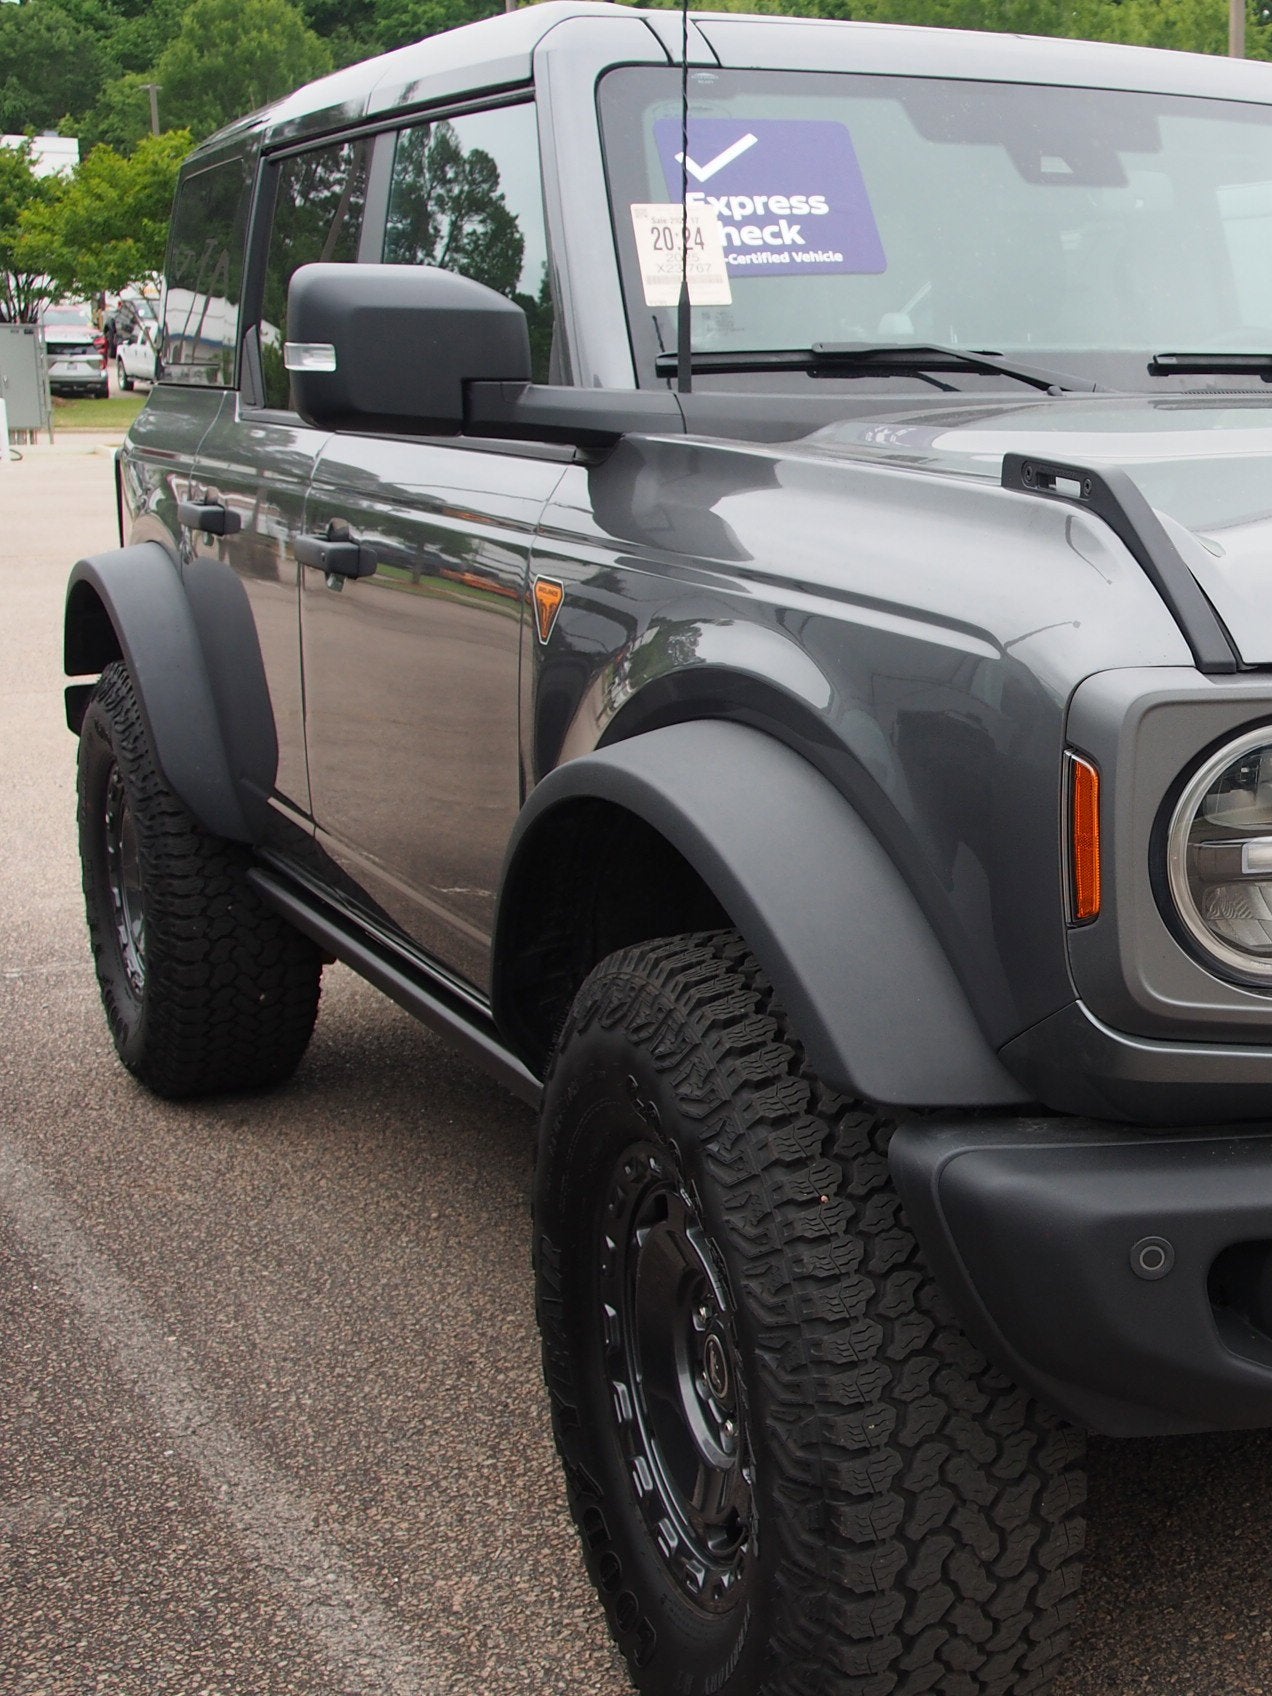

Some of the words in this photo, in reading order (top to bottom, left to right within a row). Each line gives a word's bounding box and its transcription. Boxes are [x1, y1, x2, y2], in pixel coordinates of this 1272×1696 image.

[651, 226, 705, 251] 20:24
[717, 219, 806, 247] heck
[666, 254, 700, 263] 205
[724, 251, 791, 265] -Certified
[792, 250, 844, 263] Vehicle
